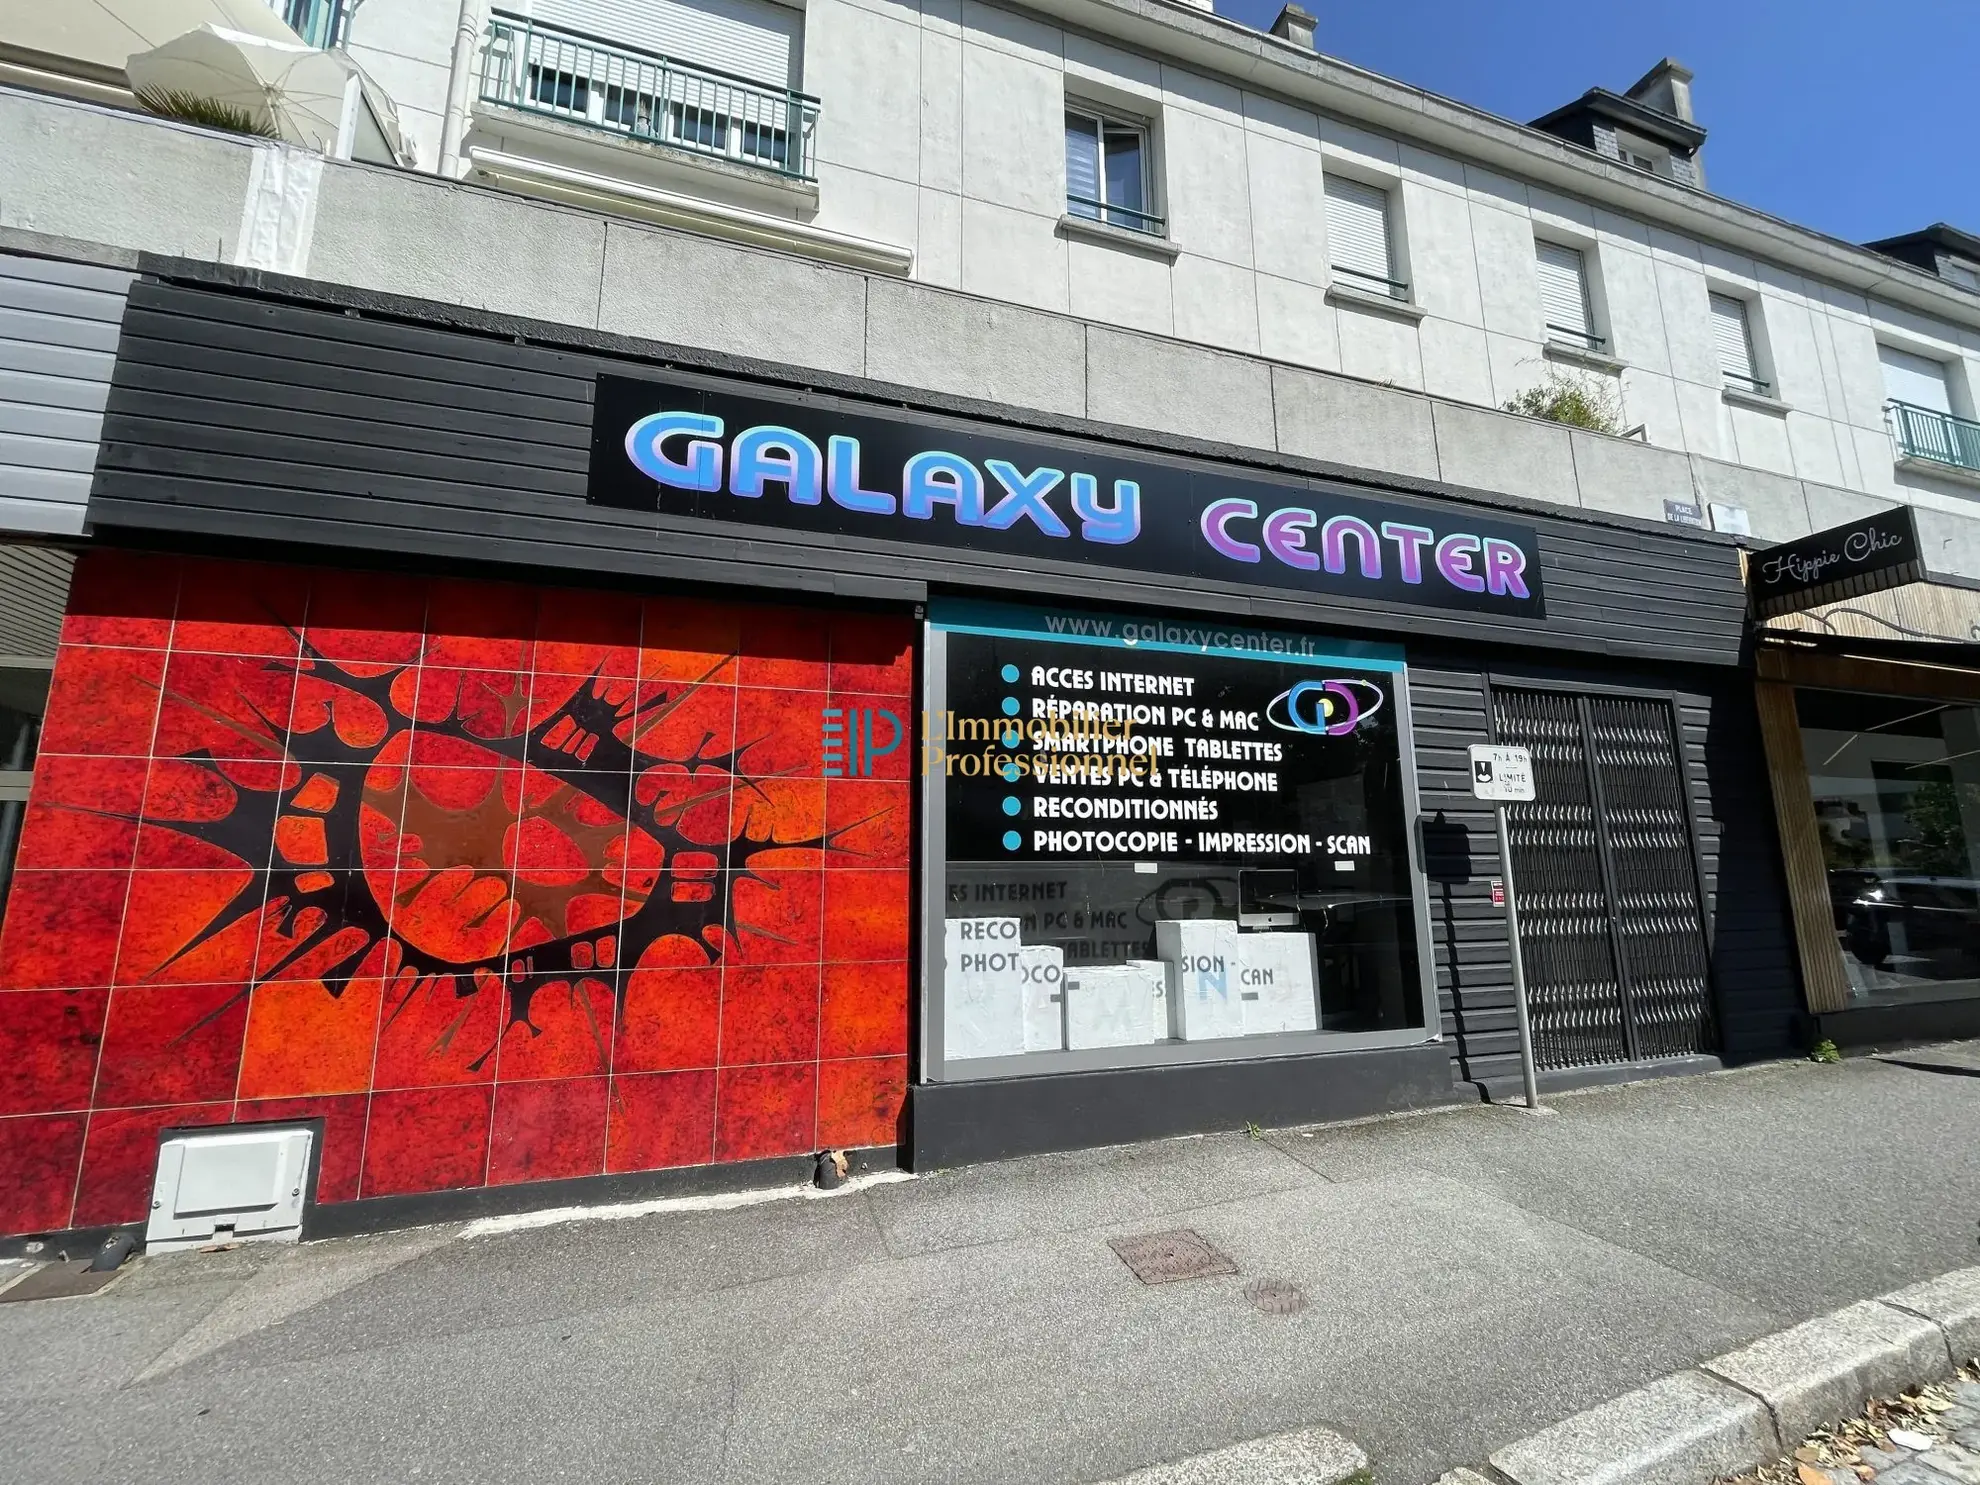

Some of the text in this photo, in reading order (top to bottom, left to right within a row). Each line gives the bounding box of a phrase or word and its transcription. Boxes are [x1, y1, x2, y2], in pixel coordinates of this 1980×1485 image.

[625, 411, 1531, 599] GALAXY CENTER
[1674, 504, 1693, 515] PLACE
[1762, 527, 1903, 584] Hippie Chic
[1045, 615, 1316, 658] www.galaxycenter.fr
[1031, 665, 1195, 697] ACCES INTERNET
[1032, 694, 1259, 731] RÉPARATION PC & MAC
[1032, 730, 1283, 762] SMARTPHONE TABLETTES
[1034, 763, 1278, 792] VENTES PC & TÉLÉPHONE
[1033, 796, 1219, 821] RECONDITIONNÉS
[1034, 830, 1178, 852] PHOTOCOPIE
[1198, 832, 1311, 854] IMPRESSION
[1327, 835, 1372, 855] SCAN
[961, 921, 1017, 940] RECO
[961, 953, 1019, 972] PHOT
